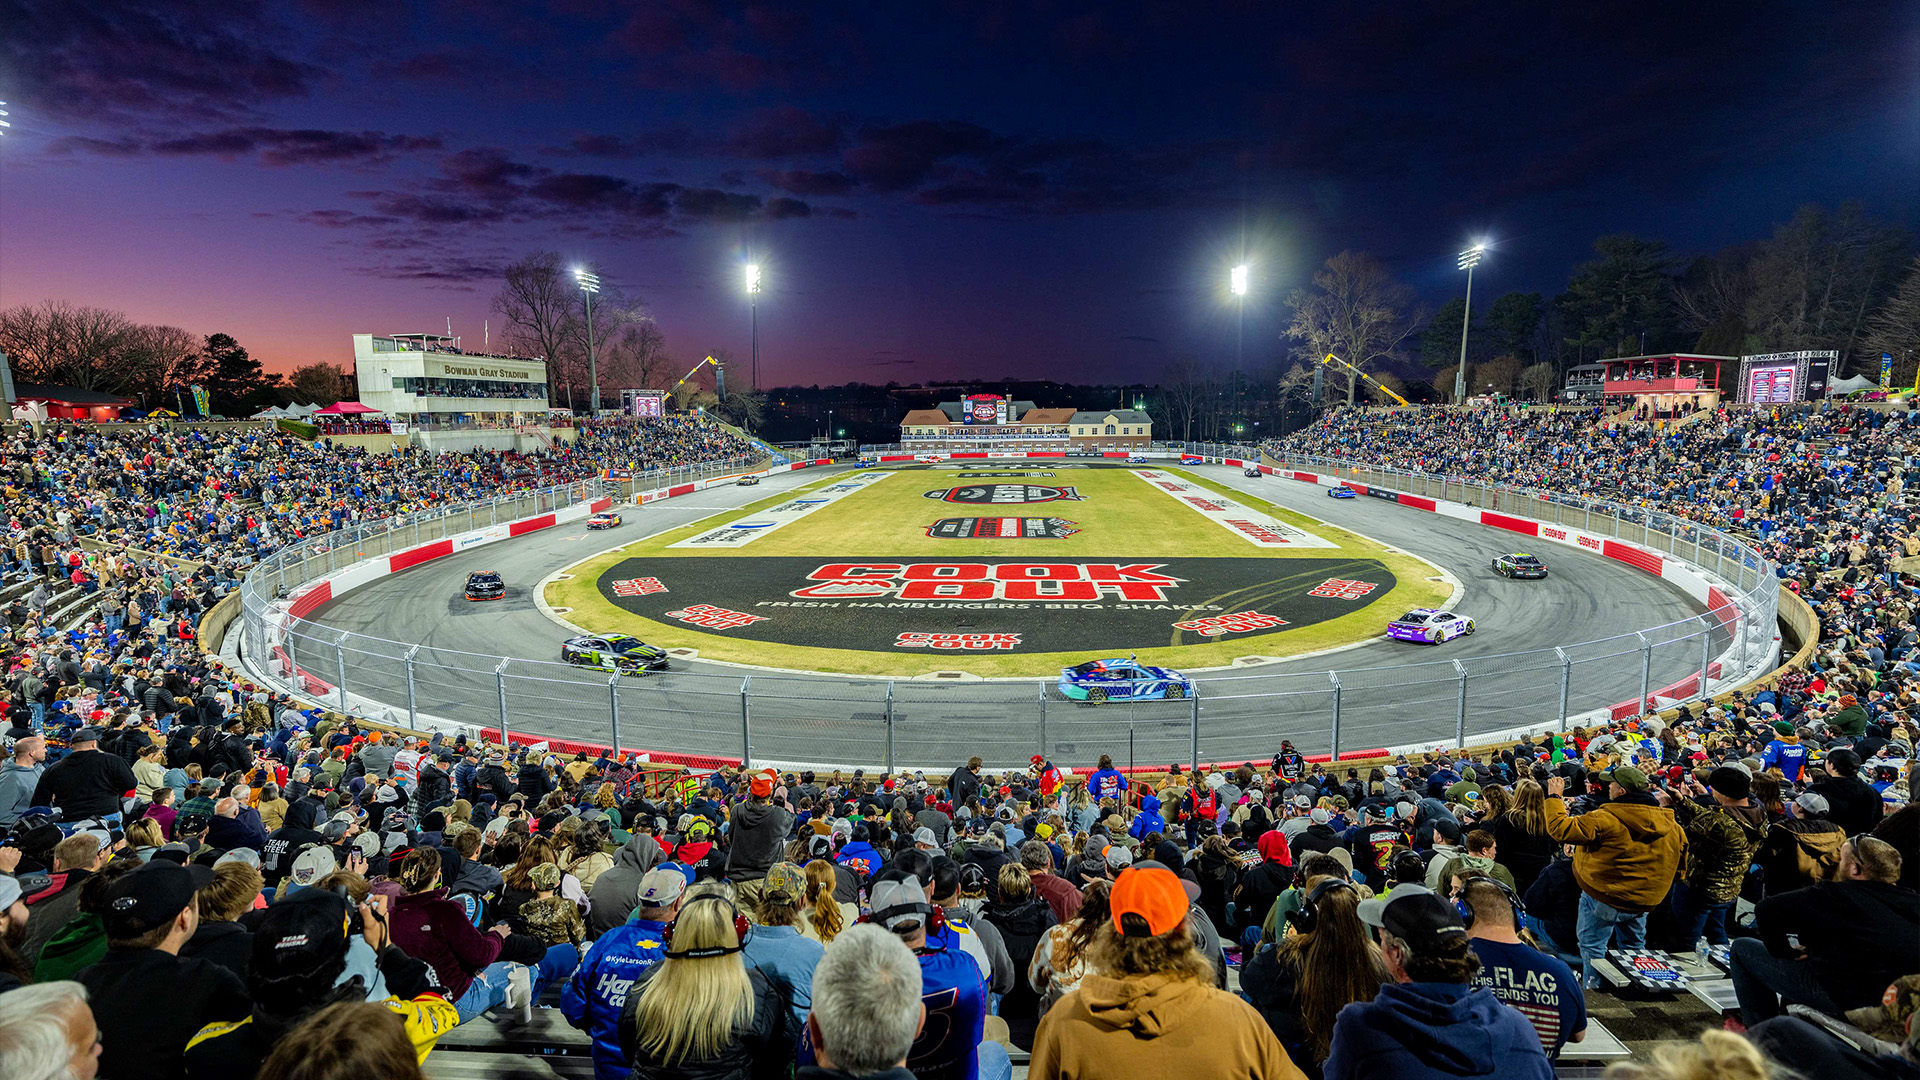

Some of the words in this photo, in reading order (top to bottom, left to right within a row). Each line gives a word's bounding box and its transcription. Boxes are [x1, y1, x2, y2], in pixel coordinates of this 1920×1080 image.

[444, 365, 477, 376] BOWMAN
[480, 368, 498, 377] GRAY
[500, 369, 529, 379] STADIUM
[806, 563, 1189, 581] COOK
[634, 577, 670, 595] COOK
[894, 580, 1179, 601] OUT
[1307, 577, 1357, 598] COOK
[683, 604, 772, 626] COOK
[1172, 610, 1268, 631] COOK
[679, 614, 741, 631] OUT
[1221, 616, 1291, 633] OUT
[1455, 621, 1465, 632] 23
[896, 632, 1022, 642] COOK
[932, 640, 1019, 650] OUT
[1134, 682, 1159, 695] 77
[267, 839, 289, 847] TEAM
[1370, 832, 1401, 842] BERRY
[264, 845, 287, 854] STEEL
[1375, 842, 1393, 867] 2
[275, 940, 308, 949] PENSKE
[282, 934, 306, 942] TEAM
[1493, 966, 1557, 993] FLAG
[1533, 992, 1559, 1006] YOU
